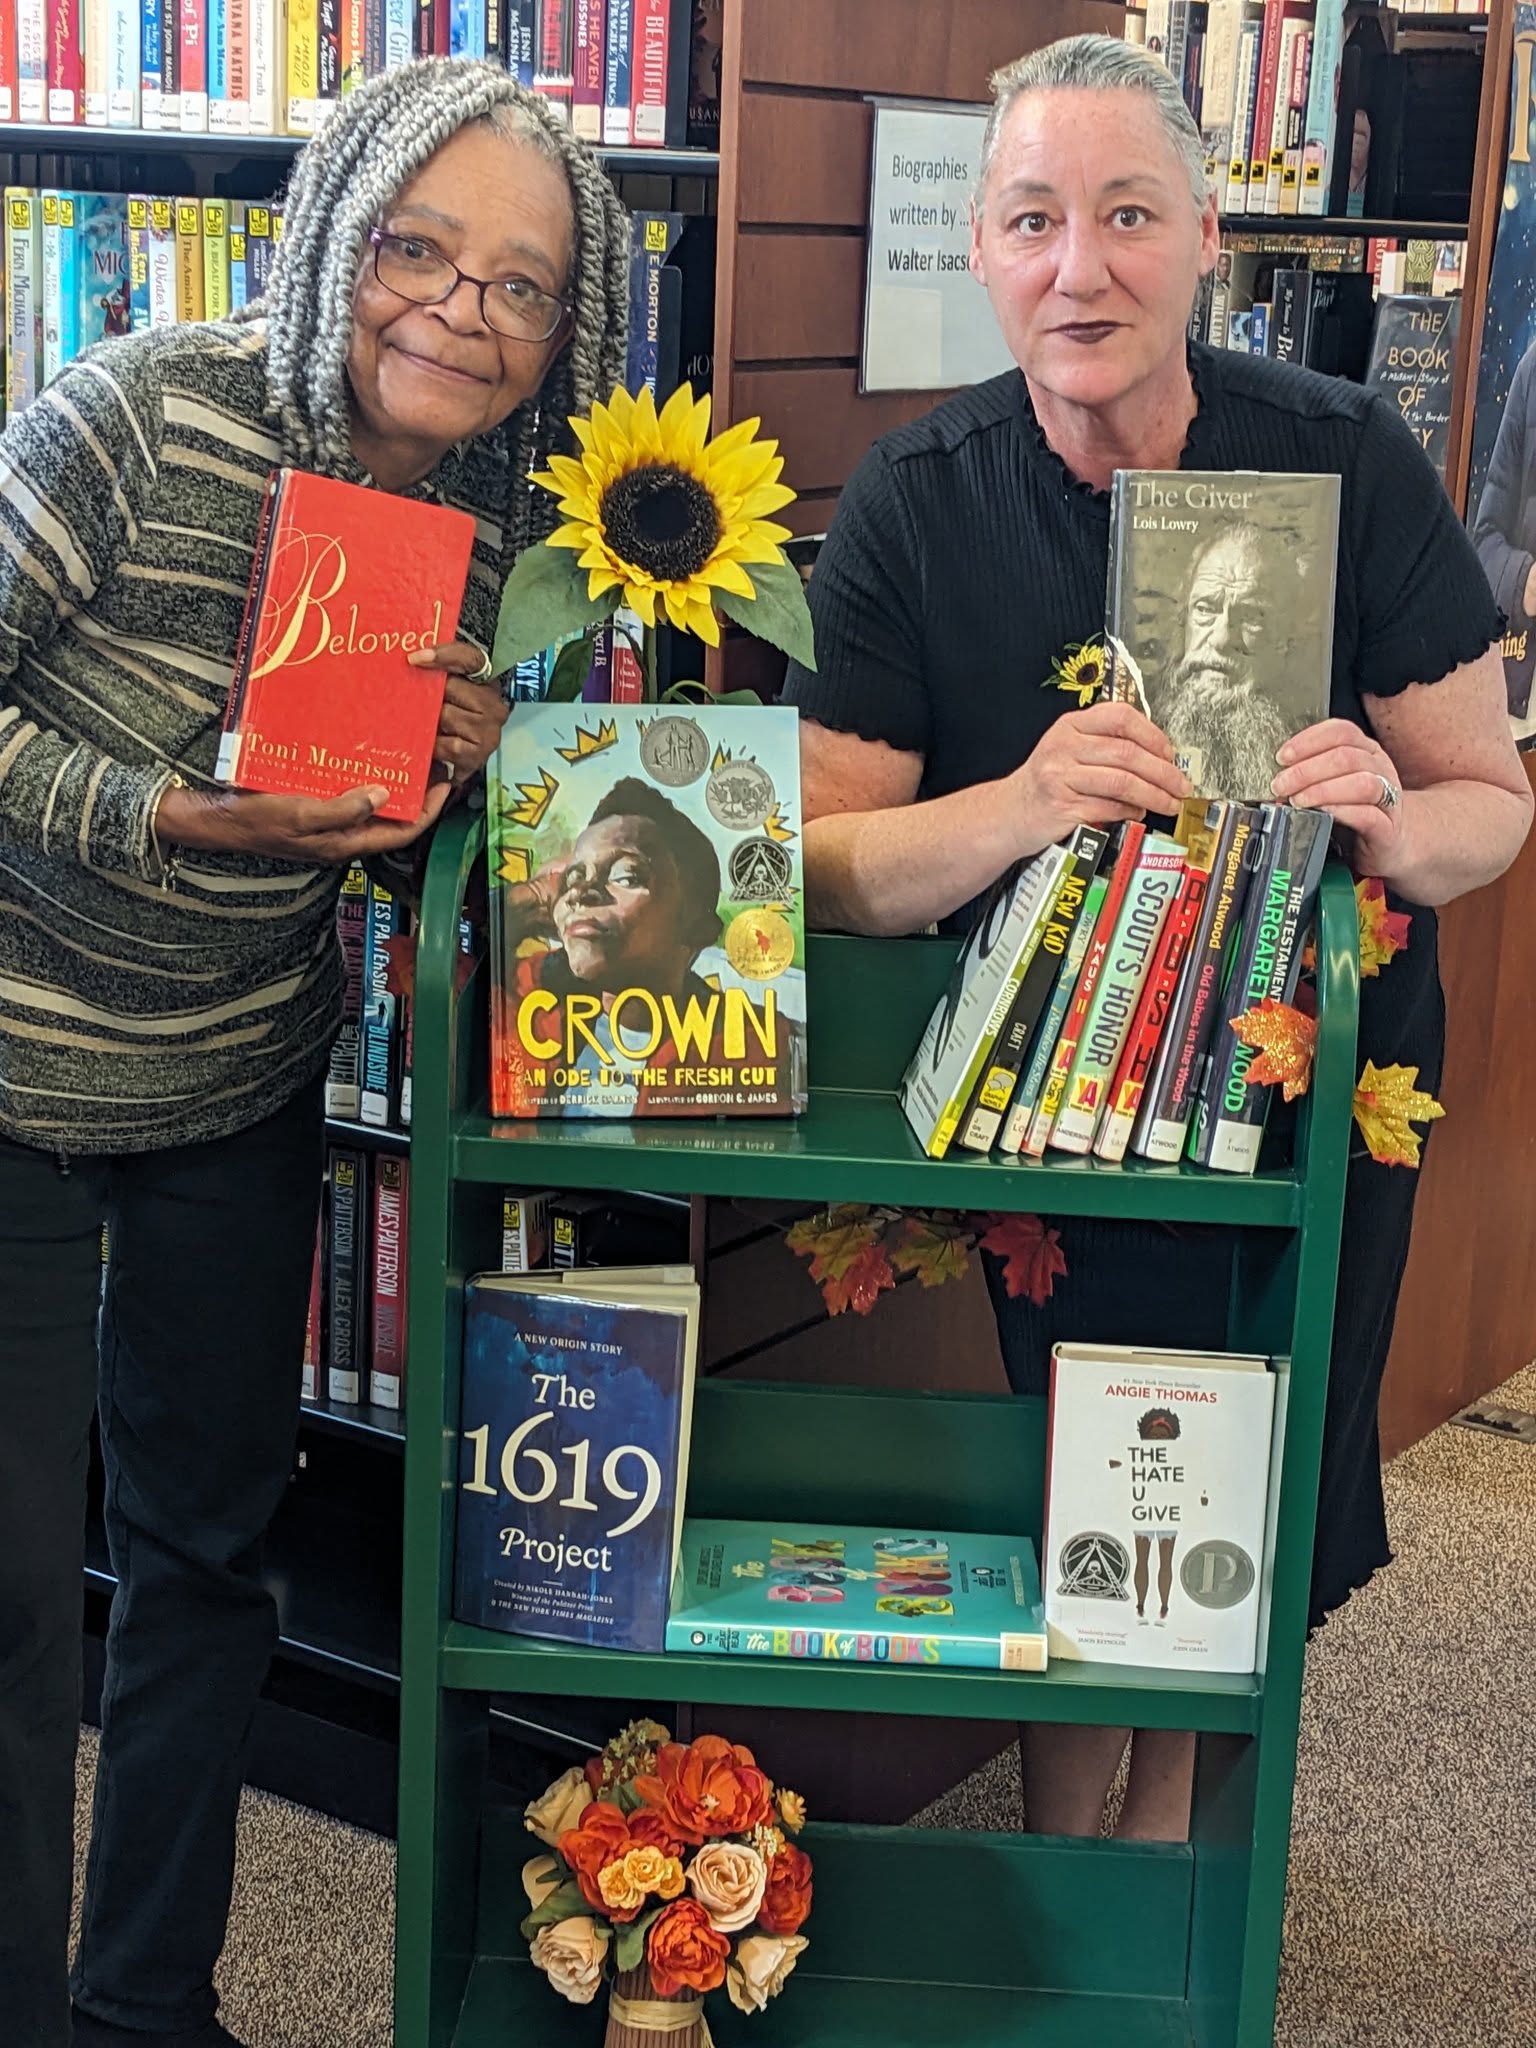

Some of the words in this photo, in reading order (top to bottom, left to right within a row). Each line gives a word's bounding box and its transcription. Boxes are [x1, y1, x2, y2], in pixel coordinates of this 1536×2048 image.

[23, 18, 31, 67] EFFECT
[182, 24, 199, 46] Pi
[520, 26, 531, 63] JENN
[32, 33, 41, 80] SISTER
[588, 18, 601, 89] HEAVEN
[231, 46, 243, 100] MATHIS
[891, 154, 968, 185] Biographies
[131, 202, 145, 216] LP
[153, 203, 168, 215] LP
[180, 208, 195, 221] LP
[207, 210, 222, 222] LP
[250, 210, 266, 224] LP
[889, 202, 938, 226] written
[940, 201, 957, 231] by
[649, 222, 665, 236] LP
[13, 237, 30, 274] FERN
[183, 240, 193, 263] The
[887, 248, 933, 272] Walter
[154, 253, 169, 306] Winter
[183, 262, 194, 302] Amish
[14, 276, 30, 338] MICHAELS
[646, 268, 660, 343] MORTON
[1408, 311, 1443, 333] THE
[1387, 346, 1450, 370] BOOK
[1397, 386, 1427, 407] OF
[1425, 410, 1450, 423] Border
[1129, 482, 1179, 508] The
[1184, 483, 1254, 511] Giver
[1133, 515, 1158, 530] Lois
[1161, 516, 1199, 534] Lowry
[249, 527, 443, 681] Beloved
[246, 731, 299, 760] Toni
[307, 742, 411, 786] Morrison
[1221, 823, 1251, 895] Margaret
[1055, 875, 1087, 920] NEW
[1287, 886, 1305, 914] THE
[1117, 877, 1170, 979] SCOUT'S
[1208, 896, 1234, 951] Atwood
[1246, 868, 1293, 1000] MARGARET
[1082, 942, 1105, 992] MAUS
[1200, 964, 1215, 987] Old
[985, 977, 1021, 1038] CORNROWS
[1193, 989, 1210, 1027] Babes
[516, 987, 777, 1066] CROWN
[1007, 1022, 1028, 1052] CRAFT
[1084, 983, 1134, 1068] HONOR
[1187, 1030, 1199, 1043] in
[366, 1024, 389, 1093] BLINDSIDE
[1182, 1044, 1196, 1067] the
[522, 1068, 547, 1088] AN
[553, 1067, 592, 1087] ODE
[598, 1067, 625, 1087] TO
[632, 1066, 668, 1087] THE
[674, 1066, 733, 1087] FRESH
[739, 1066, 777, 1086] CUT
[1171, 1065, 1190, 1103] Wood
[559, 1092, 599, 1106] DERRICK
[695, 1093, 735, 1105] GORDON
[736, 1093, 746, 1105] C.
[747, 1093, 778, 1105] JAMES
[969, 1131, 990, 1142] CRAFT
[1151, 1138, 1178, 1150] ATWOOD
[337, 1162, 354, 1174] LP
[377, 1185, 401, 1229] JAMES
[334, 1195, 353, 1257] PATTERSON
[556, 1218, 571, 1230] LP
[376, 1229, 399, 1297] PATTERSON
[335, 1276, 353, 1310] ALEX
[334, 1317, 351, 1366] CROSS
[513, 1332, 523, 1342] A
[524, 1333, 548, 1345] NEW
[550, 1336, 587, 1350] ORIGIN
[590, 1341, 623, 1356] STORY
[531, 1373, 597, 1411] The
[1105, 1384, 1151, 1399] ANGIE
[1155, 1388, 1218, 1404] THOMAS
[1127, 1447, 1168, 1464] THE
[462, 1411, 662, 1538] 1619
[1131, 1466, 1185, 1483] HATE
[1132, 1486, 1146, 1501] U
[1131, 1505, 1182, 1522] GIVE
[499, 1526, 613, 1573] Project
[494, 1579, 516, 1591] Created
[517, 1583, 525, 1592] by
[525, 1583, 553, 1595] NIKOLE
[534, 1595, 541, 1604] of
[541, 1596, 550, 1605] the
[498, 1599, 512, 1610] THE
[513, 1602, 530, 1614] NEW
[531, 1604, 550, 1616] YORK
[552, 1608, 575, 1620] TIMES
[575, 1612, 614, 1626] MAGAZINE
[746, 1632, 771, 1651] the
[772, 1628, 841, 1659] BOOK
[839, 1637, 856, 1656] of
[856, 1635, 941, 1665] BOOKS
